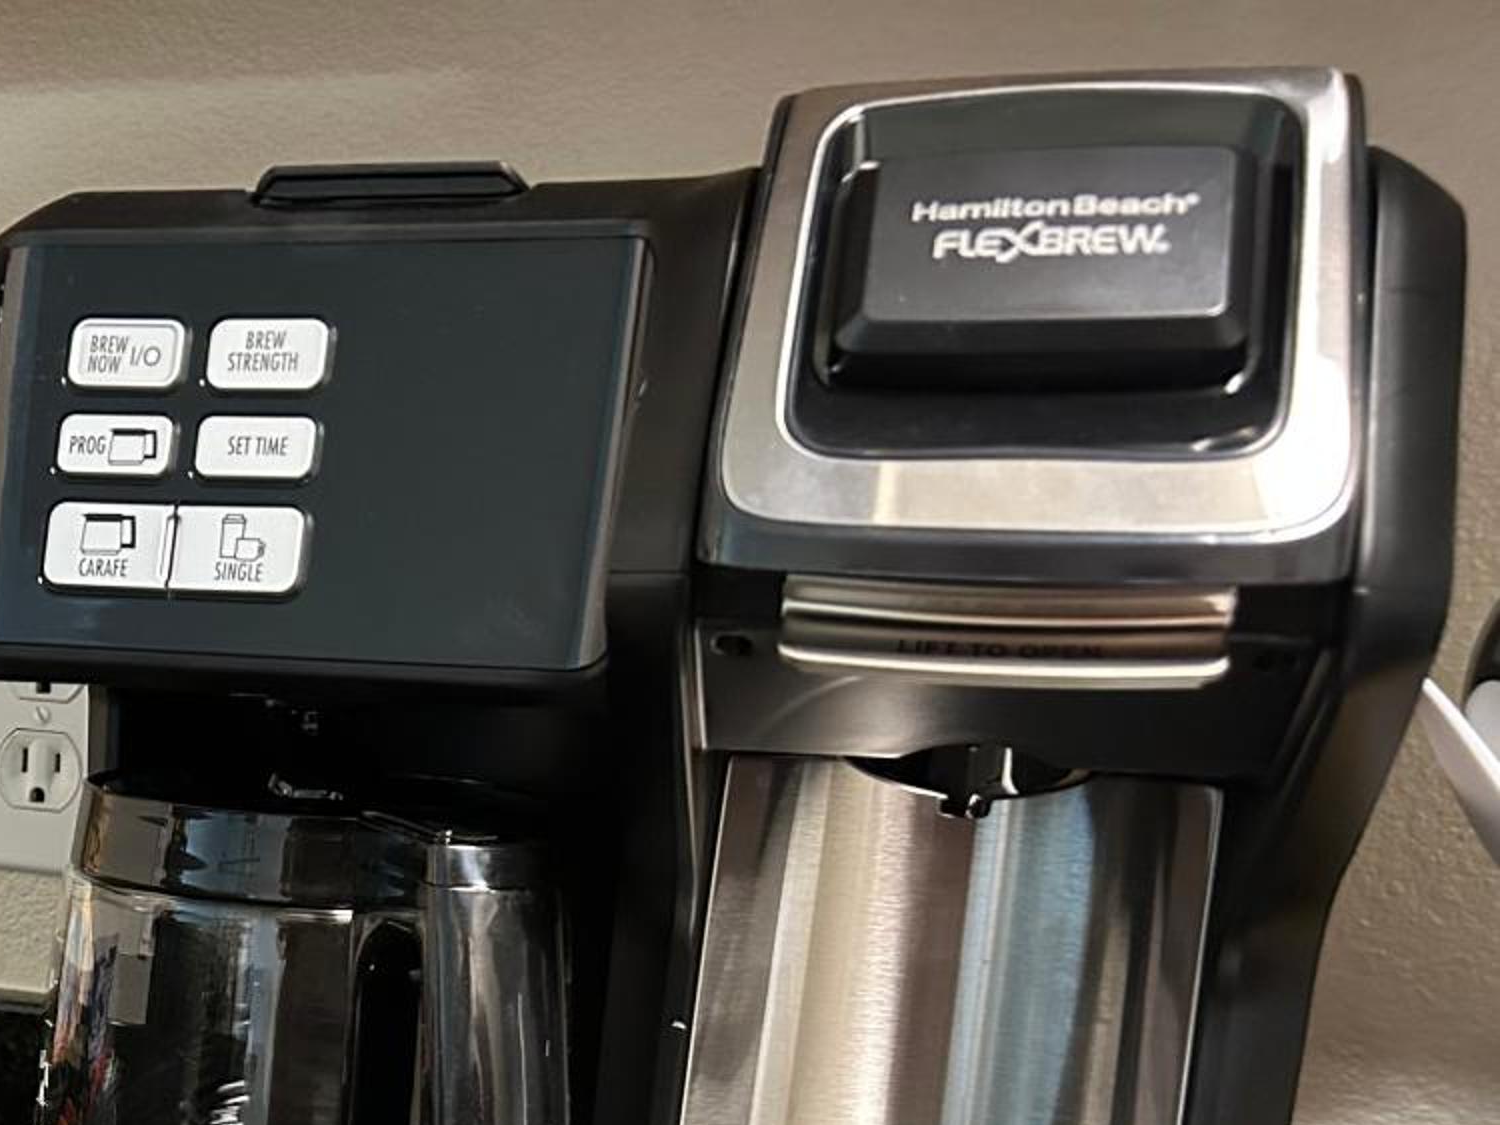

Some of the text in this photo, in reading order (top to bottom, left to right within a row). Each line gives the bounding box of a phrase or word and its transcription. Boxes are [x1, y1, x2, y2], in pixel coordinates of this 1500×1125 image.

[90, 335, 129, 354] BREW
[245, 330, 288, 351] BREW
[88, 355, 121, 374] NOW
[227, 351, 299, 372] STRENGTH
[69, 435, 106, 455] PROG
[227, 436, 289, 456] SET TIME
[78, 558, 128, 578] CARAFE
[214, 561, 264, 582] SINGLE
[896, 639, 1105, 660] LIFT TO OPEN
